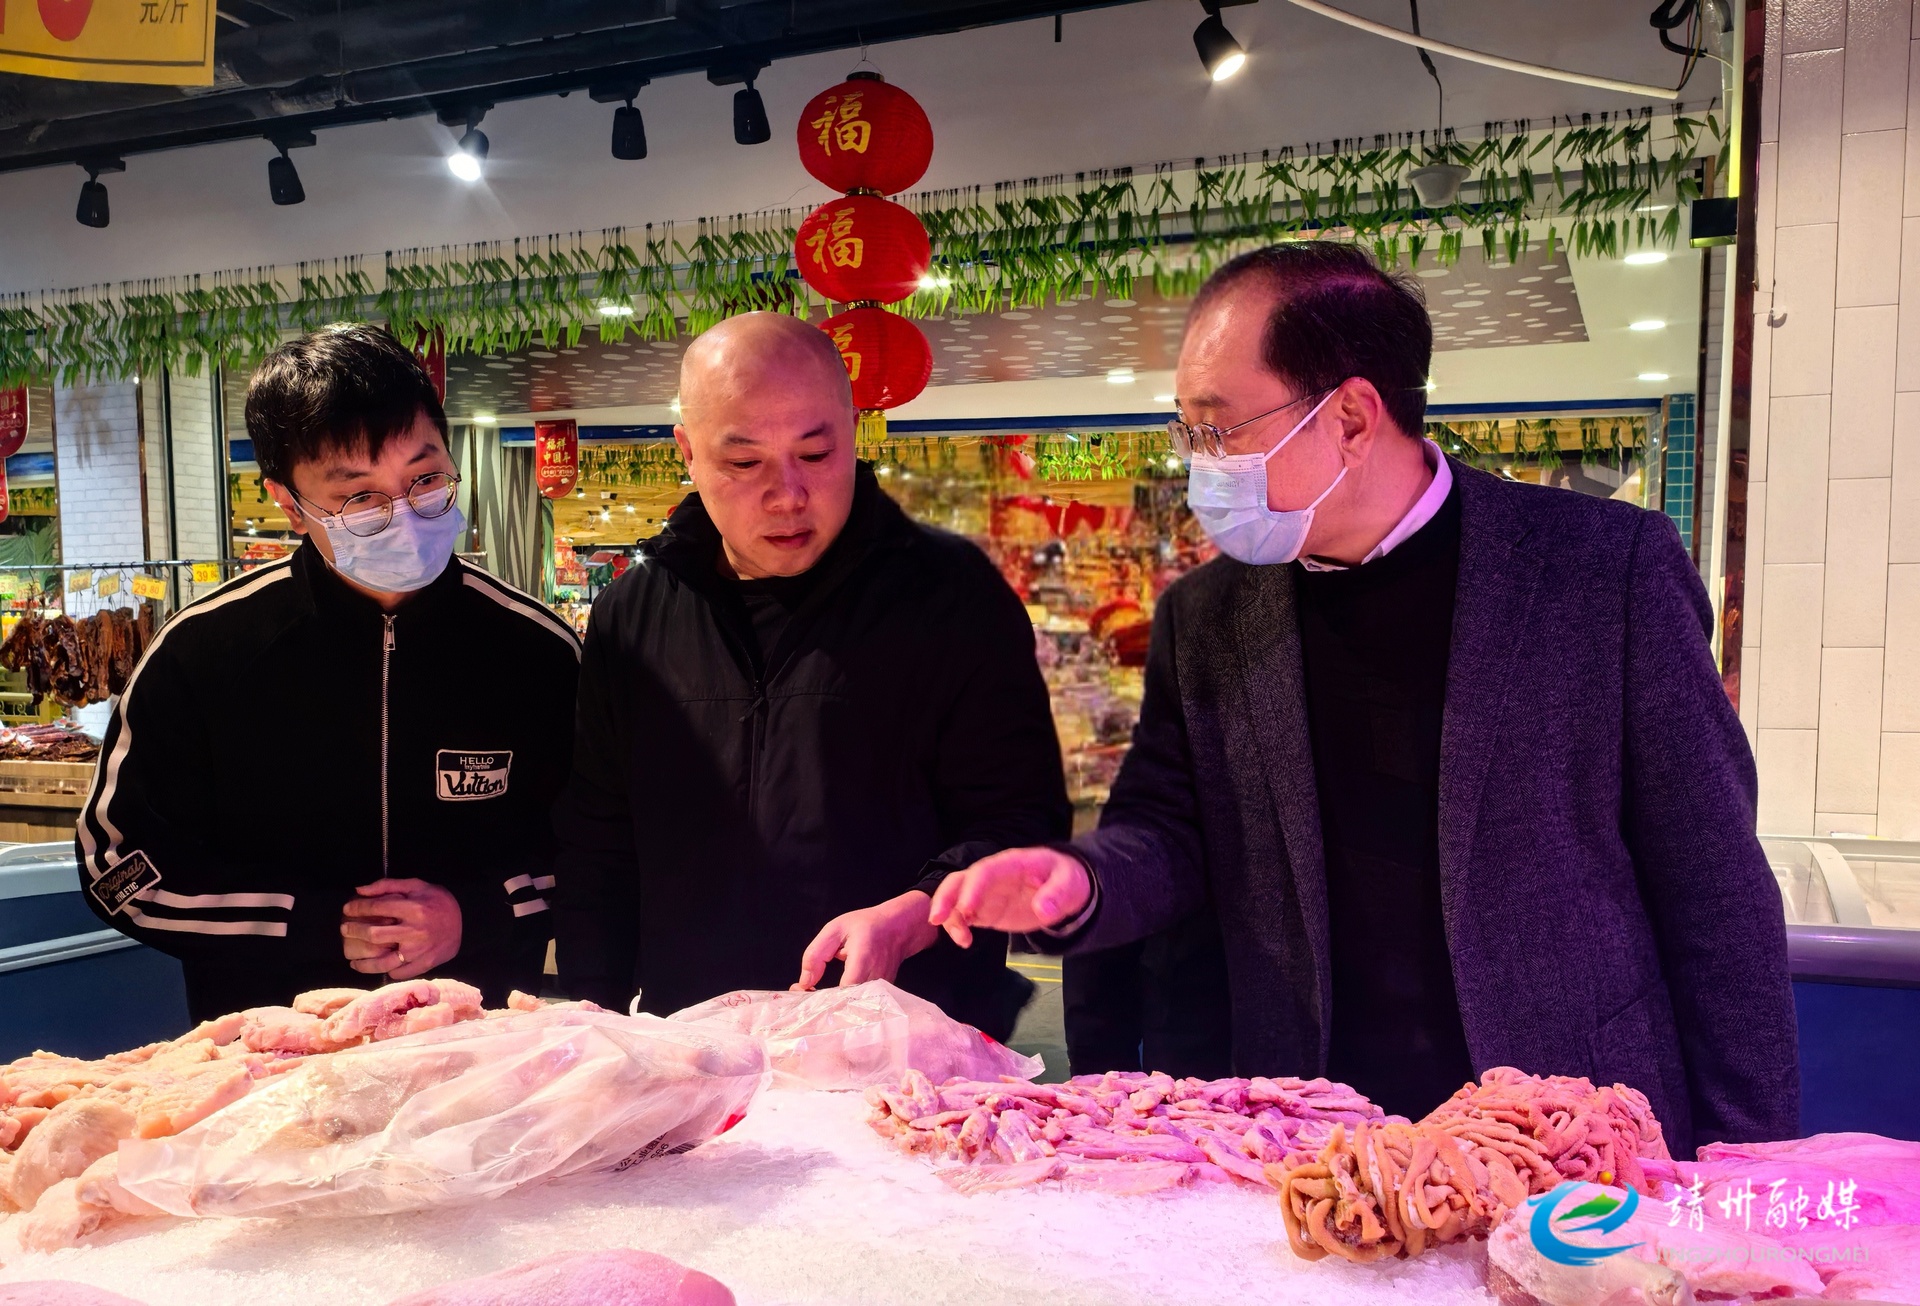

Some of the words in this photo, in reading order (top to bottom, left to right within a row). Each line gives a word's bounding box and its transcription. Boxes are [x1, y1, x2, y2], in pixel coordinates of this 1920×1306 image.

[811, 91, 872, 157] 福
[805, 207, 864, 274] 福
[134, 582, 147, 595] 29
[460, 756, 495, 765] HELLO
